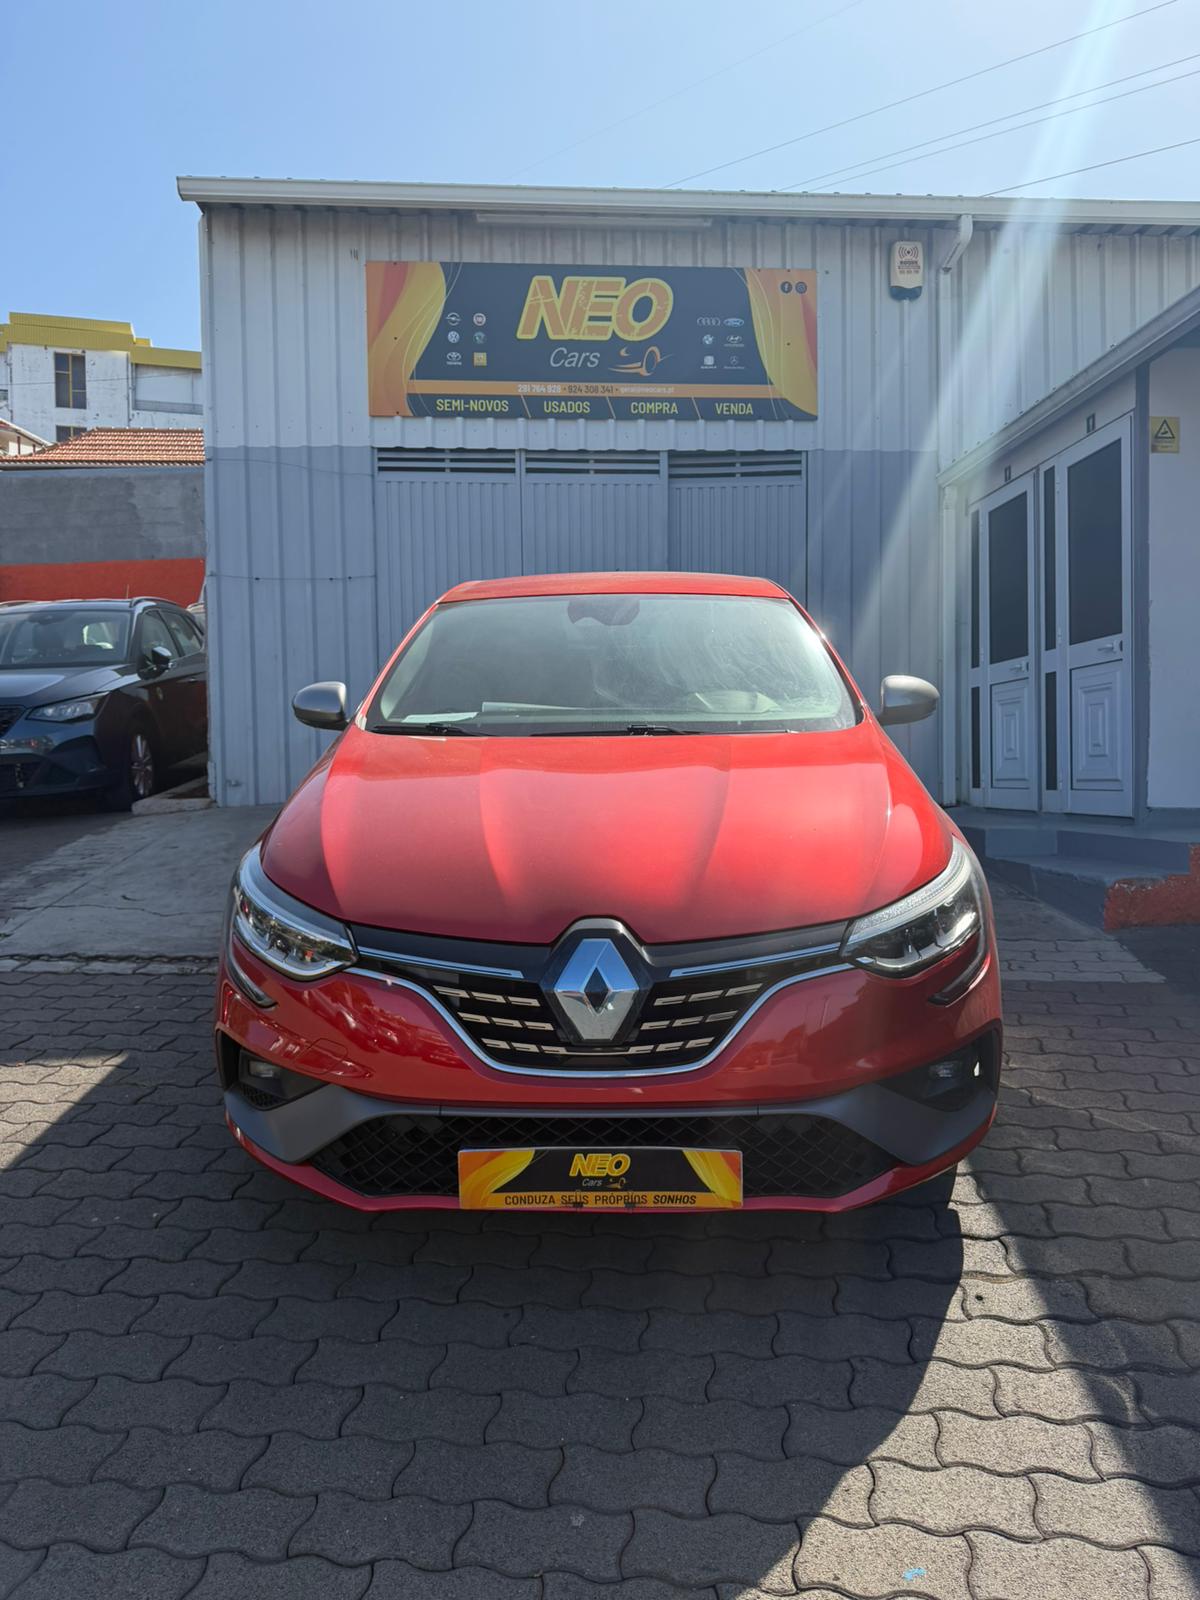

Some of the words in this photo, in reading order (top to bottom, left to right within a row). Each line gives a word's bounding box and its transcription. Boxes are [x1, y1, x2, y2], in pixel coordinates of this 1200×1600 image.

[516, 275, 674, 342] NEO
[550, 347, 600, 368] Cars
[568, 384, 582, 394] 924
[600, 384, 613, 394] 341
[436, 399, 509, 412] SEMI-NOVOS
[543, 401, 591, 413] USADOS
[630, 402, 679, 415] COMPRA
[715, 403, 754, 415] VENDA
[569, 1153, 631, 1177] NEO
[582, 1177, 602, 1187] Cars
[504, 1195, 555, 1205] CONDUZA
[560, 1194, 589, 1205] SEUS
[594, 1192, 648, 1205] PRÓPRIOS
[652, 1194, 697, 1205] SONHOS
